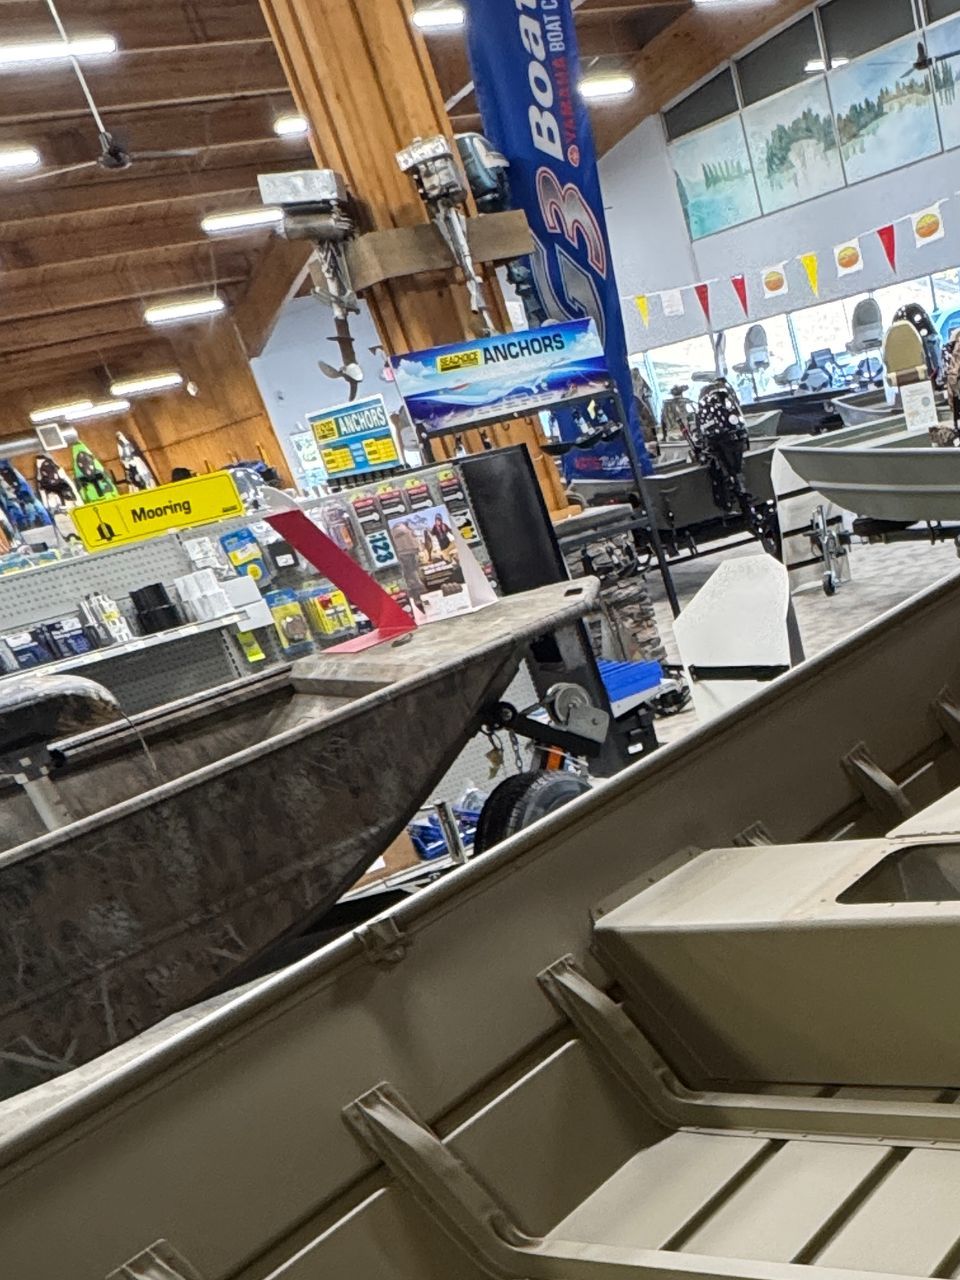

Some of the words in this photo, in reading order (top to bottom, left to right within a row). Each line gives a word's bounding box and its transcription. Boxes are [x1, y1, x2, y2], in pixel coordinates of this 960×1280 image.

[543, 13, 567, 52] BOAT
[528, 166, 607, 349] G3
[483, 333, 566, 364] ANCHORS
[338, 405, 389, 436] ANCHORS
[131, 500, 191, 523] Mooring
